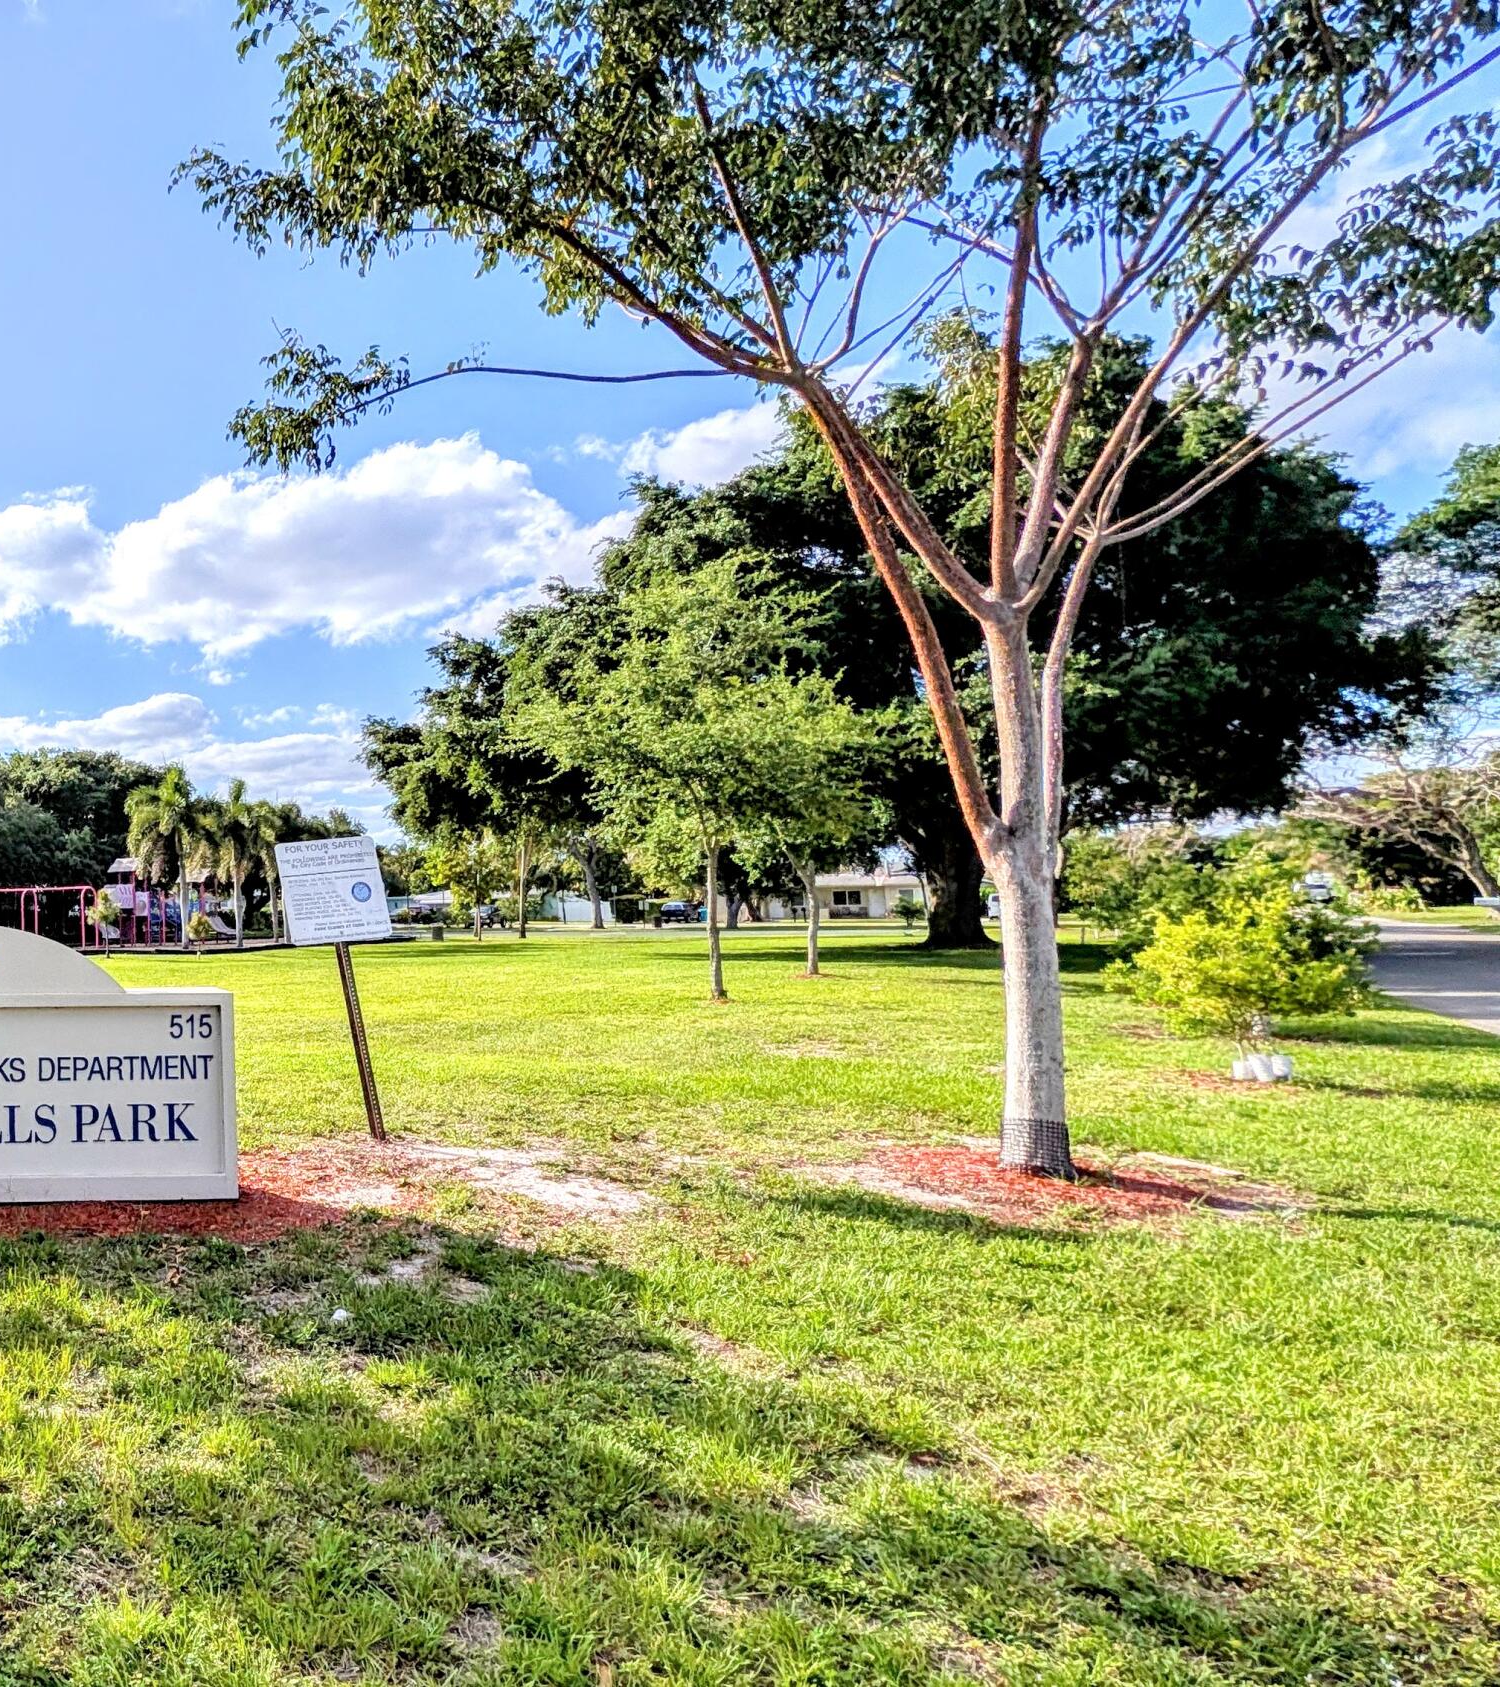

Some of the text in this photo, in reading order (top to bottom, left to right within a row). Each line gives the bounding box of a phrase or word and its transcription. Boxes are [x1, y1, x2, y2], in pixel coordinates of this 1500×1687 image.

[284, 840, 363, 854] FOR YOUR SAFETY
[170, 1014, 212, 1039] 515
[39, 1055, 214, 1081] DEPARTMENT
[71, 1103, 198, 1142] PARK
